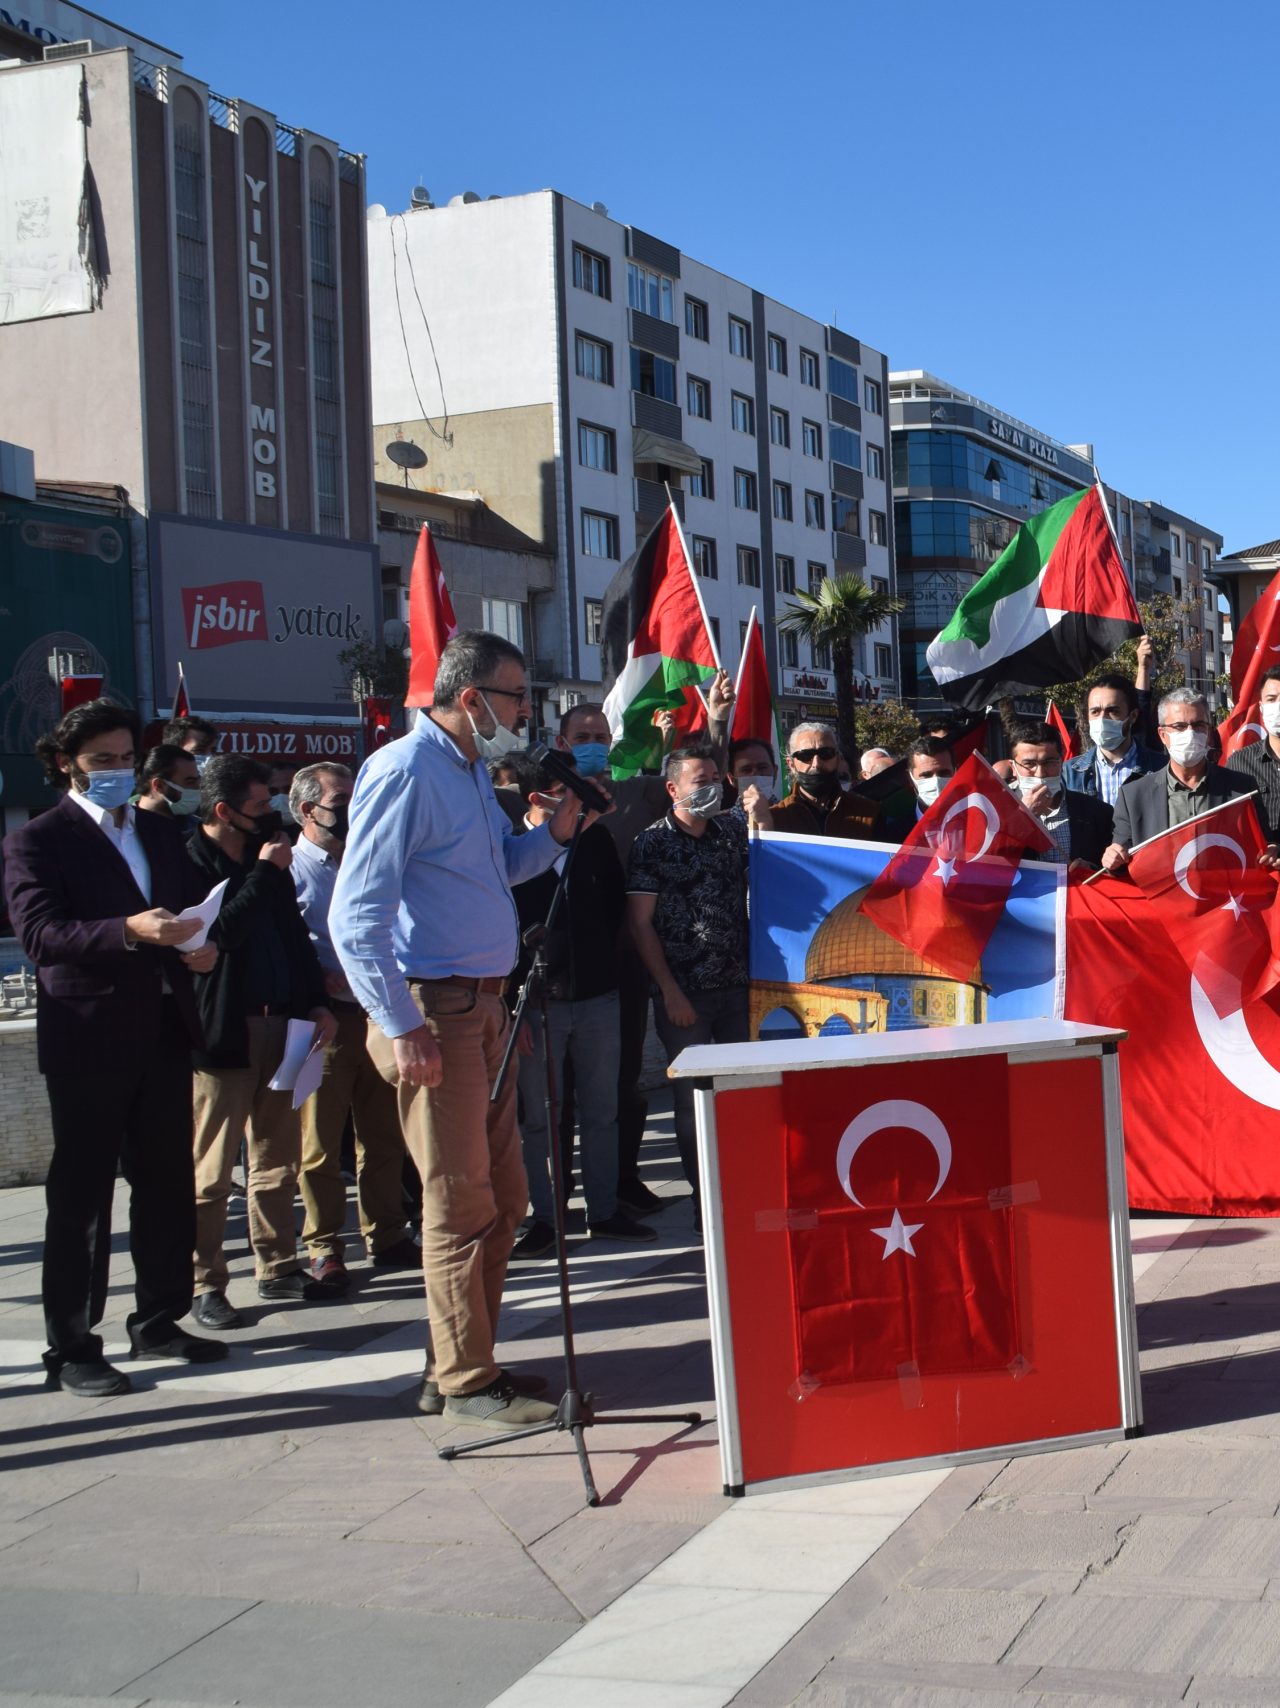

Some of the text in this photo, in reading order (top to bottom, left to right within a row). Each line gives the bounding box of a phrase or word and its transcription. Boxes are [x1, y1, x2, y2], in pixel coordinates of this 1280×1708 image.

[245, 173, 276, 498] YILDIZ MOB
[1030, 438, 1058, 464] PLAZA
[274, 602, 361, 643] yatak
